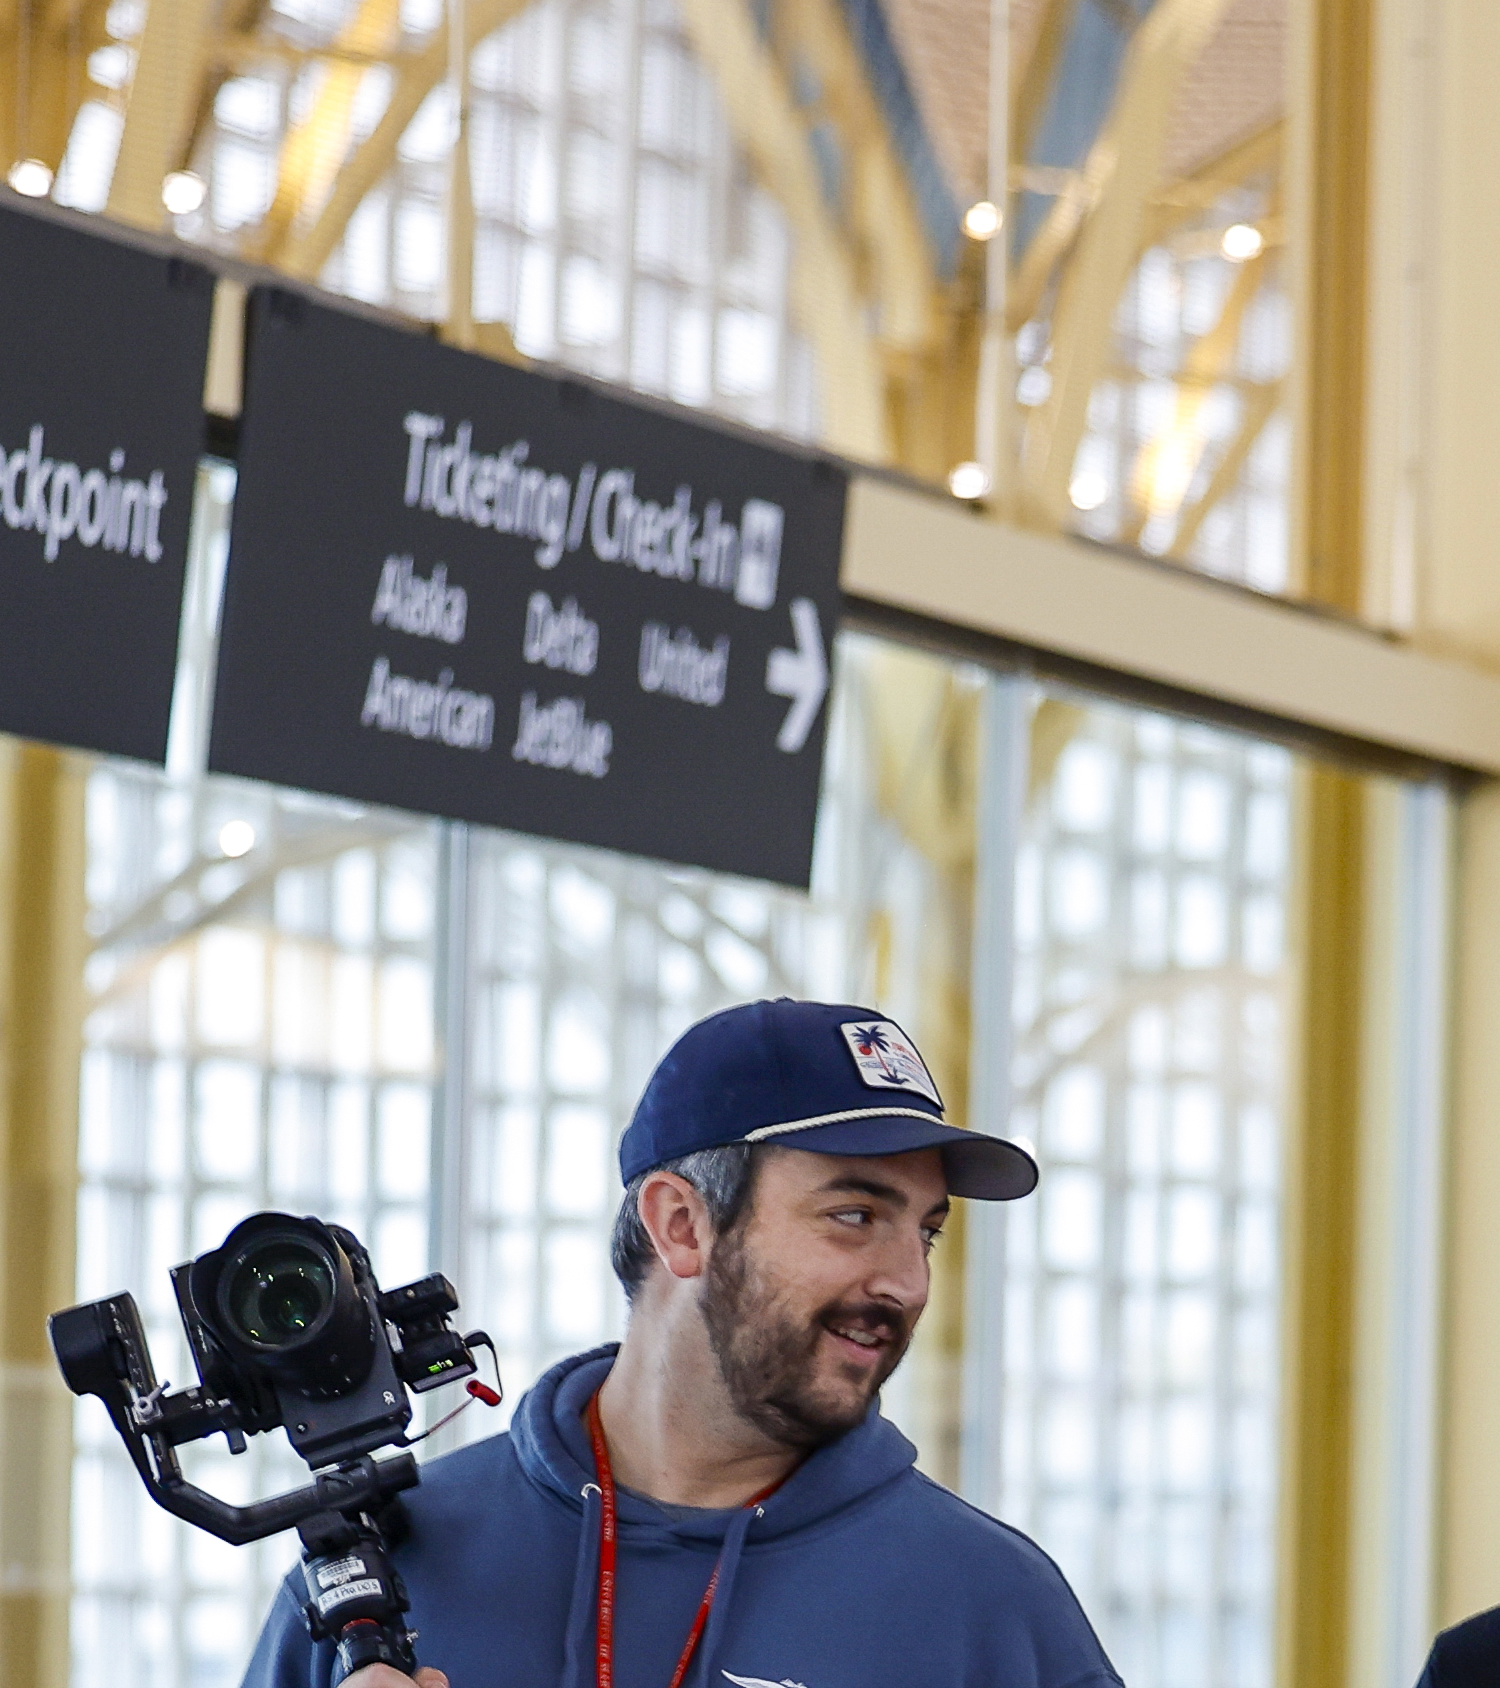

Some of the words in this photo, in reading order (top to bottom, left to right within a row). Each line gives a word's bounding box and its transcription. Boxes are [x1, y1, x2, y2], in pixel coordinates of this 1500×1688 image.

[372, 556, 468, 643] Alaska
[524, 591, 598, 676] Delta
[639, 622, 729, 706] United
[362, 657, 494, 750] American
